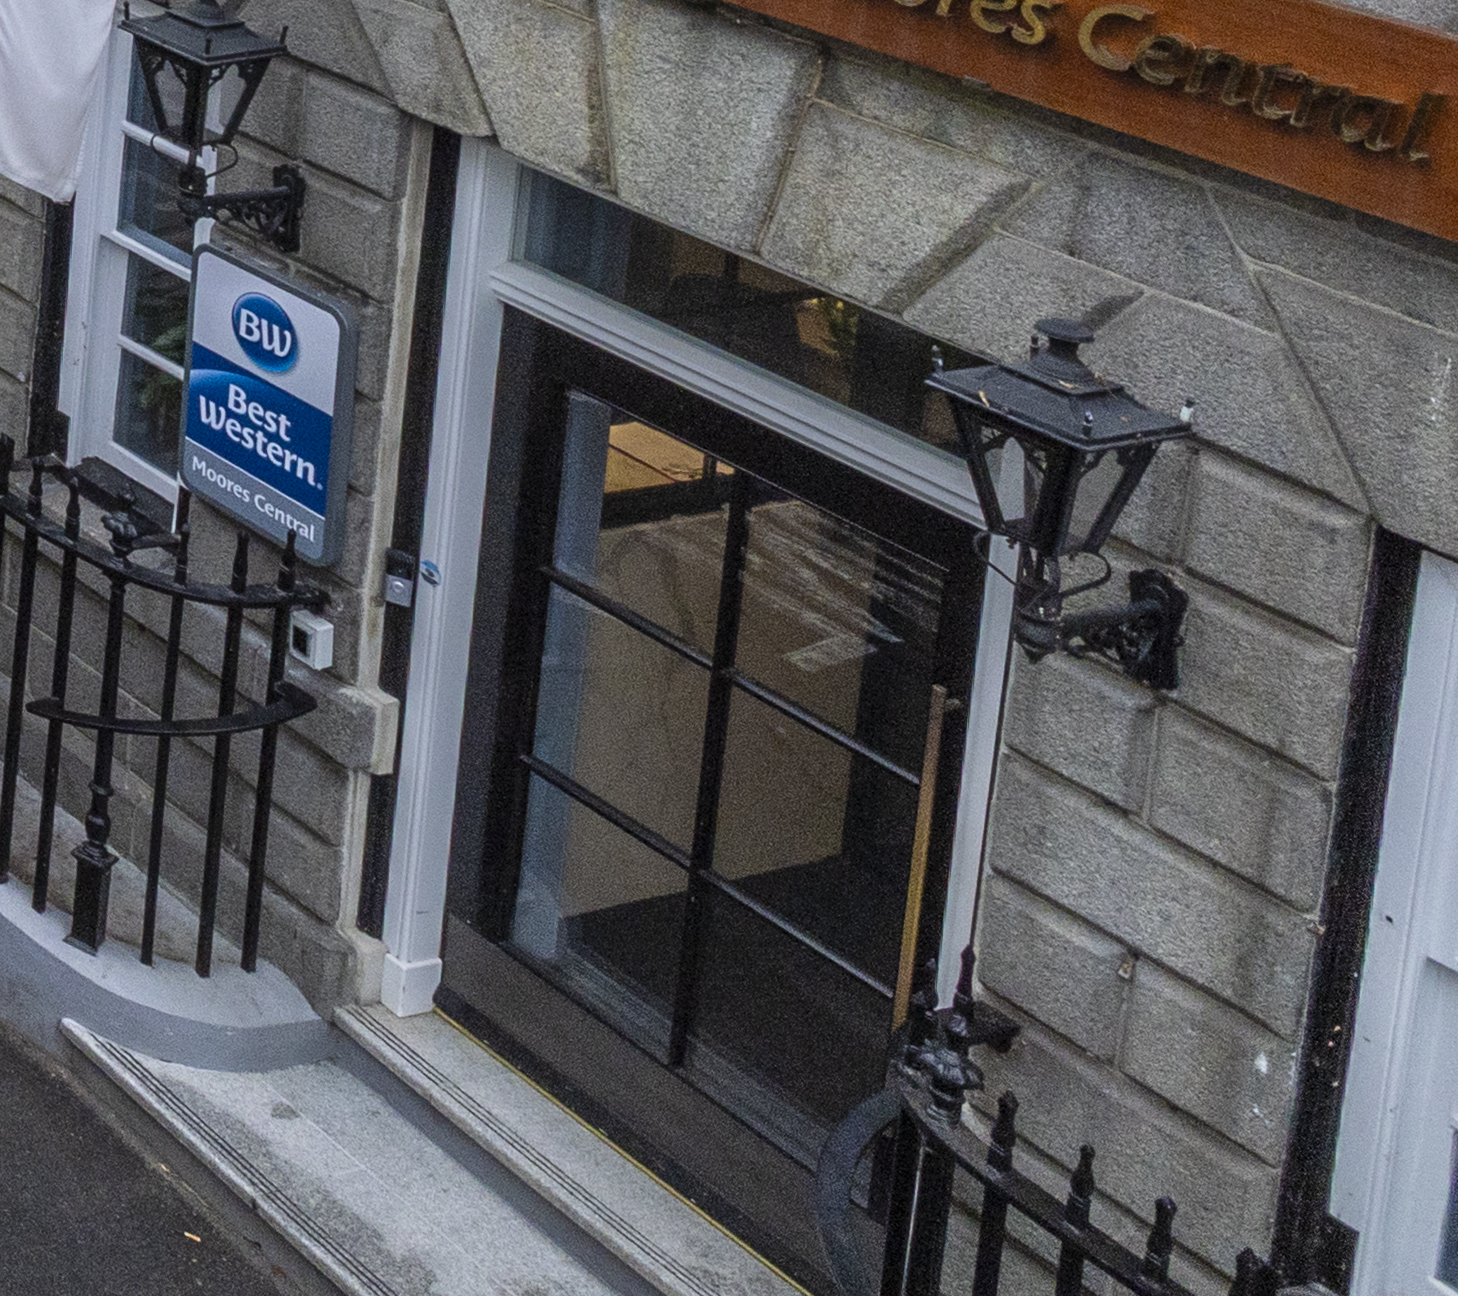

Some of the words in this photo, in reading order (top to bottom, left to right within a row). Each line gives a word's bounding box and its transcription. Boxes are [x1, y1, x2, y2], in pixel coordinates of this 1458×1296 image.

[1076, 4, 1441, 163] Central
[237, 307, 293, 358] BW
[228, 383, 292, 442] Best
[192, 455, 251, 503] Moores
[254, 493, 316, 543] Central
